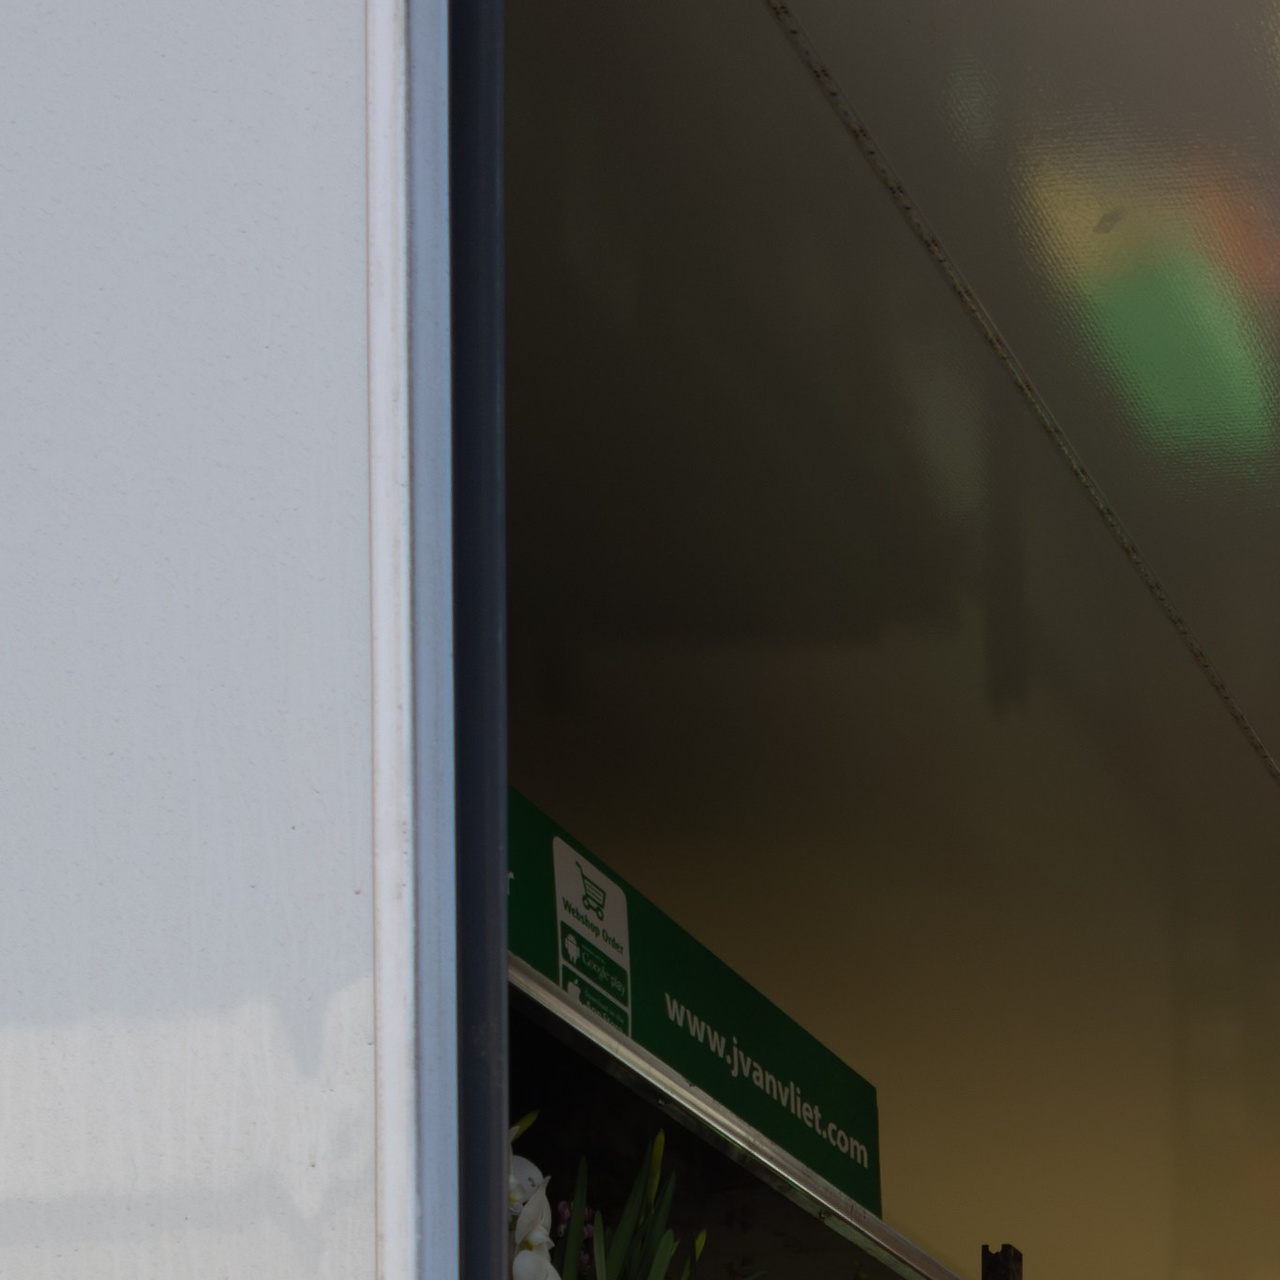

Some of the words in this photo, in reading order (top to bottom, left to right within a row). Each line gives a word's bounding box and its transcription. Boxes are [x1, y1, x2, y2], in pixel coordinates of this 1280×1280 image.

[562, 897, 599, 937] Webshop
[602, 929, 623, 955] Order
[664, 991, 869, 1170] www.jvanvliet.com
